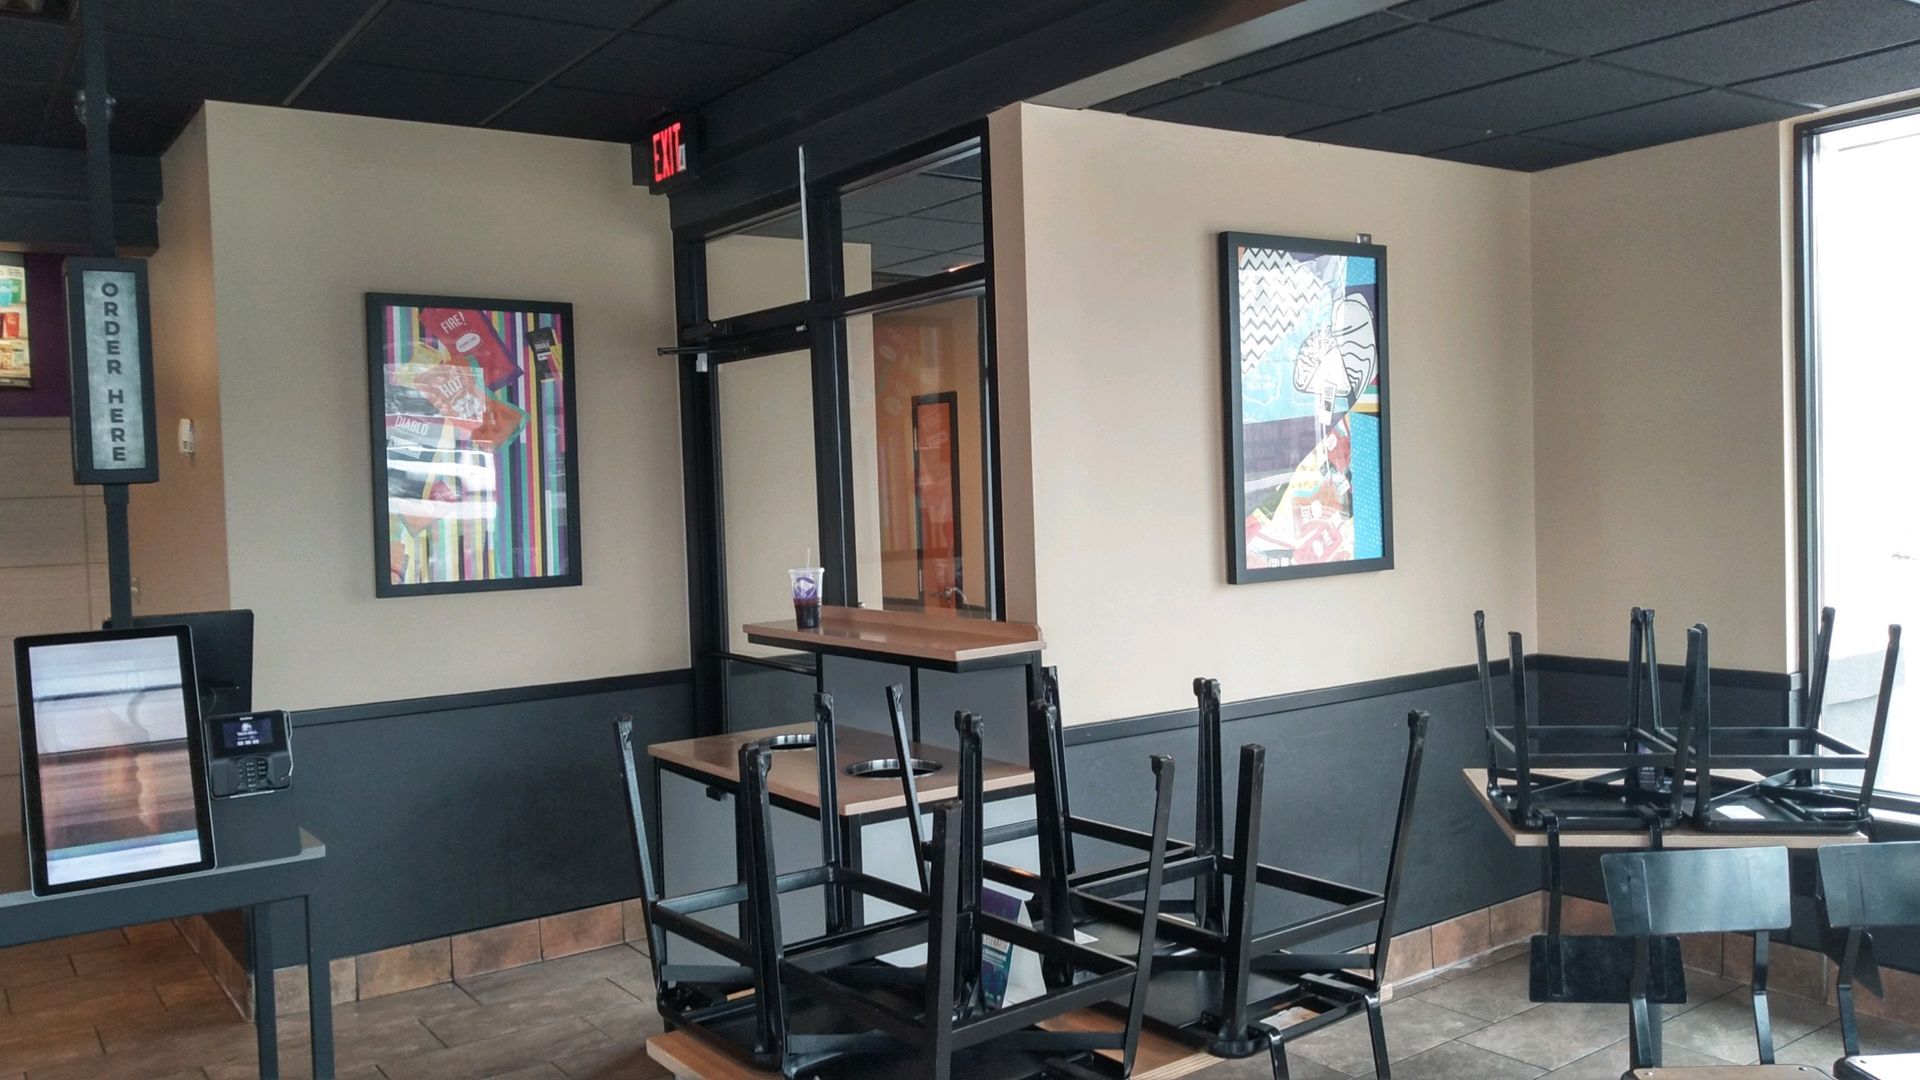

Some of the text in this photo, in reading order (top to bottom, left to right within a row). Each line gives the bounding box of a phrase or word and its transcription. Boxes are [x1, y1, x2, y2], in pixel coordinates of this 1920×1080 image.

[652, 122, 681, 183] EXIT
[440, 311, 467, 334] FIRE!
[101, 282, 126, 462] ORDER HERE
[438, 375, 463, 399] HOT
[394, 415, 429, 435] DIABLO
